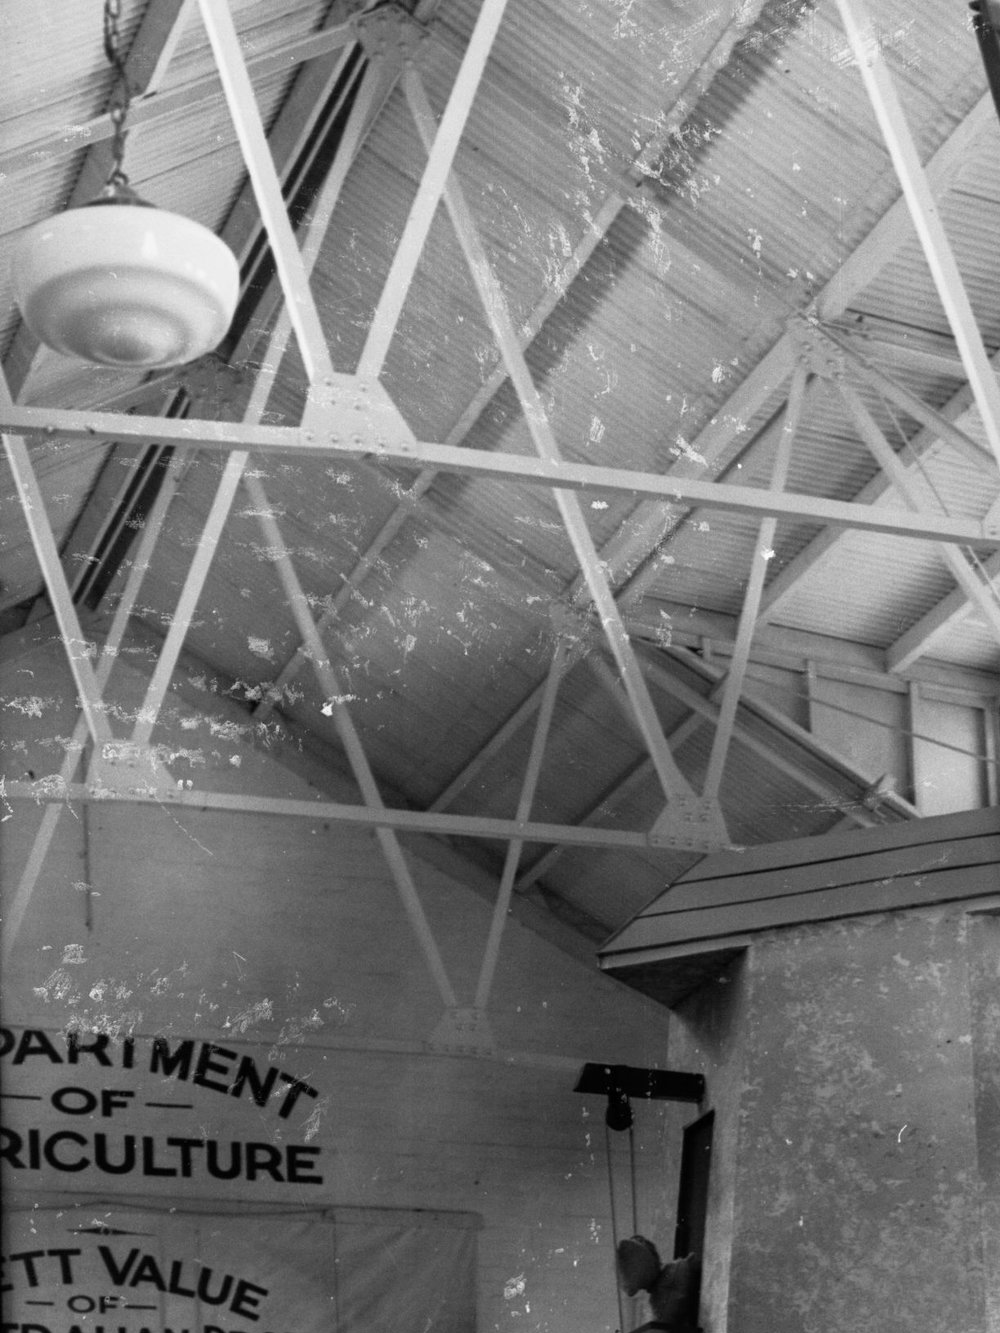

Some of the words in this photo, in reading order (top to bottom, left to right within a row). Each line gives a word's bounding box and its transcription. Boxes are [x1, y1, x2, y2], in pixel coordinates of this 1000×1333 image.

[51, 1087, 135, 1117] OF
[98, 1245, 269, 1322] VALUE
[67, 1295, 118, 1314] OF
